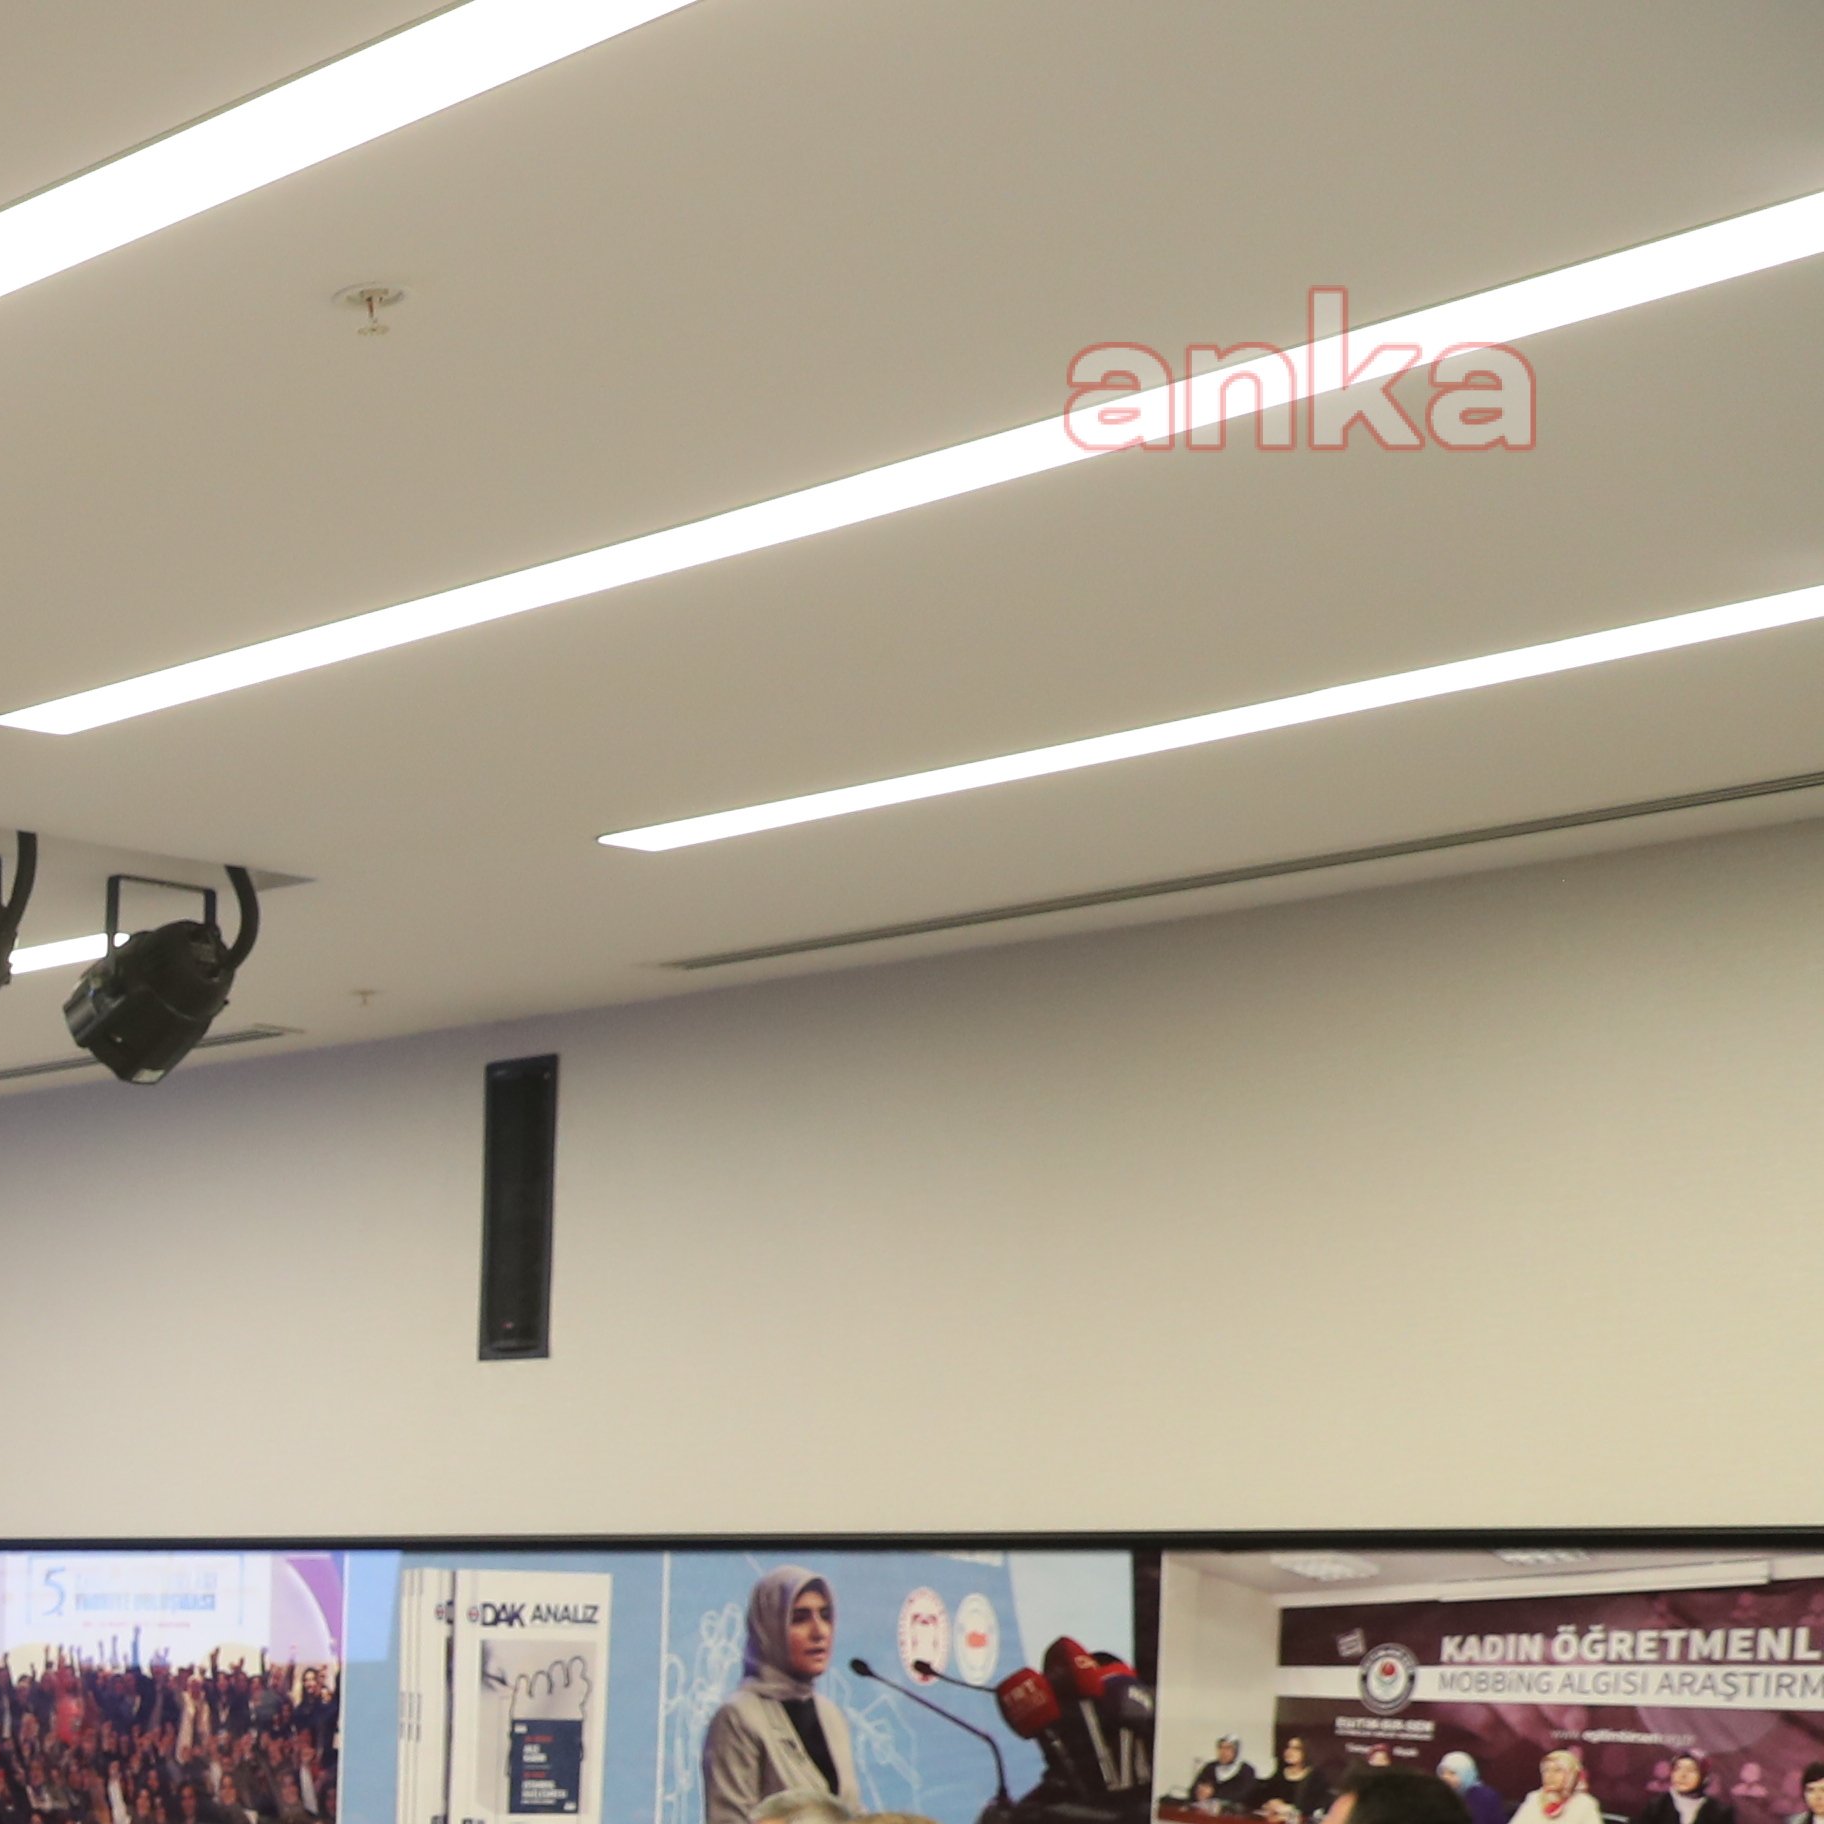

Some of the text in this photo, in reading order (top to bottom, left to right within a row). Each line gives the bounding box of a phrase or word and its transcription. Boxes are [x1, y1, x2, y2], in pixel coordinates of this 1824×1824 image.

[1440, 1623, 1823, 1663] KADIN ÖĞRETMENL
[1556, 1671, 1650, 1697] ALGISI
